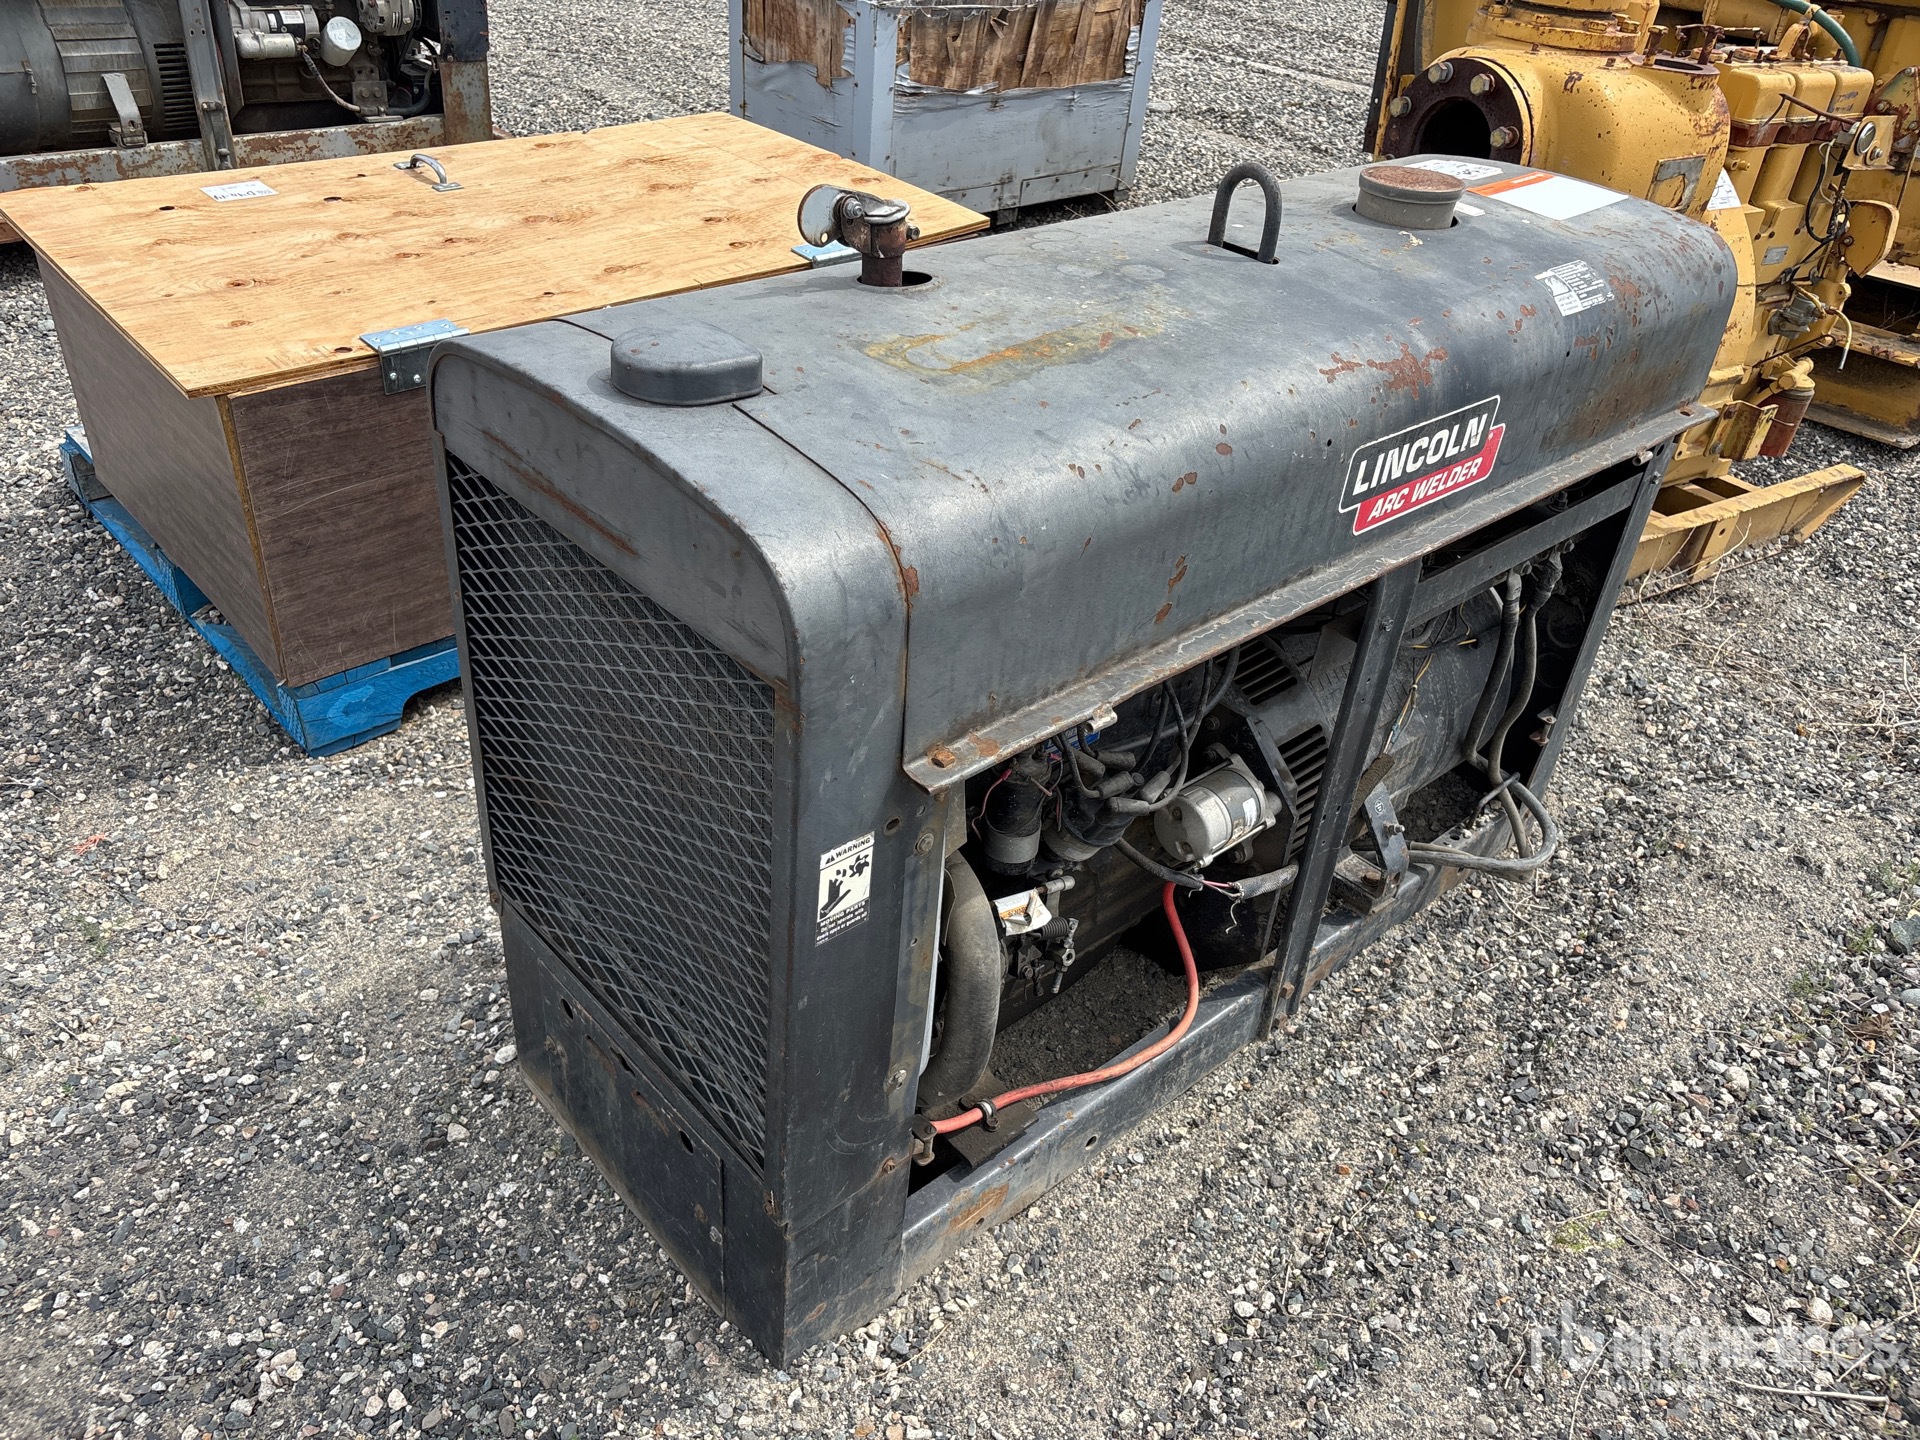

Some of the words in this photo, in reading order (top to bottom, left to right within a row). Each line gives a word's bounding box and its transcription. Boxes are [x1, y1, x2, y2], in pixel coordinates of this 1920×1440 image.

[1352, 413, 1489, 496] LINCOLN
[1366, 487, 1410, 523] ARC
[1411, 457, 1483, 503] WELDER
[835, 837, 871, 858] WARNING
[820, 911, 845, 927] MOVING
[845, 900, 866, 914] PARTS
